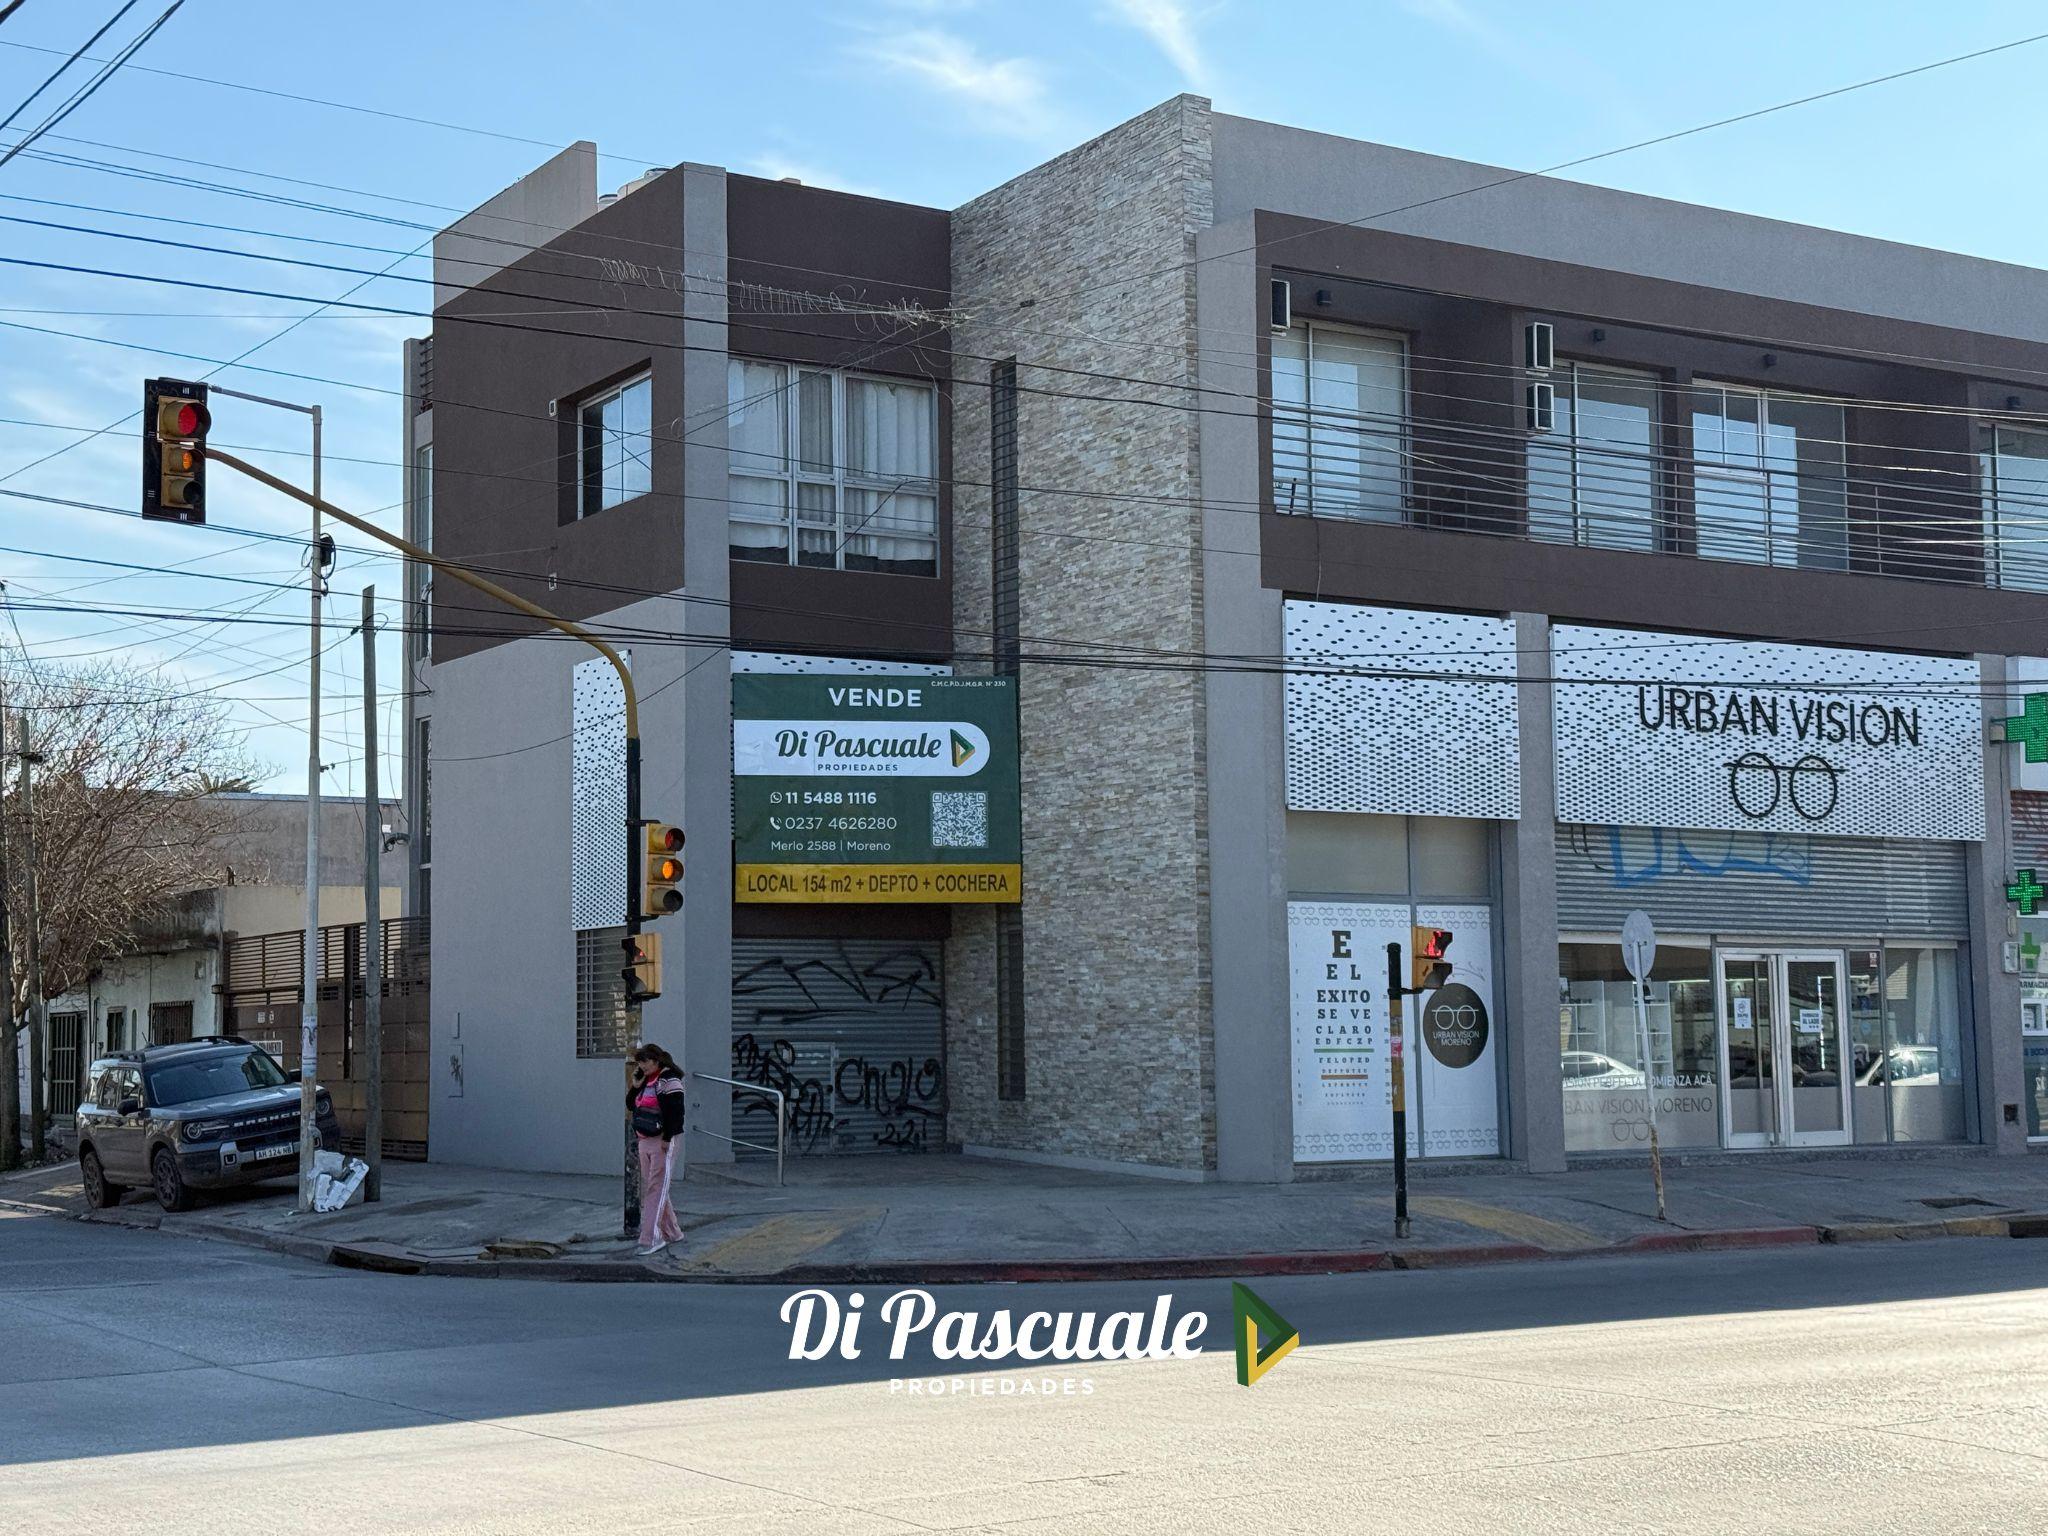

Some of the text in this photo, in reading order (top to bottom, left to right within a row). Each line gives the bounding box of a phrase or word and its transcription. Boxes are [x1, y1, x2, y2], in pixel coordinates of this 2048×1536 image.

[828, 687, 922, 707] VENDE
[1638, 685, 1920, 747] URBAN VISION
[775, 729, 942, 758] Di Pascuale
[817, 764, 898, 772] PROPIEDADES
[785, 791, 877, 804] 11 5488 1116
[785, 817, 897, 830] 0237 4626280
[771, 840, 803, 851] Merlo
[807, 841, 836, 851] 2588
[847, 841, 891, 851] Moreno
[748, 874, 798, 893] LOCAL
[802, 874, 826, 893] 154
[831, 874, 852, 893] m2
[869, 874, 918, 893] DEPTO
[935, 874, 1008, 893] COCHERA
[1331, 930, 1352, 958] E
[1317, 989, 1371, 1003] EXITO
[1317, 1008, 1371, 1019] SE VE
[1315, 1025, 1372, 1034] CLARO
[1432, 1031, 1480, 1039] URBAN VISION
[1652, 1075, 1691, 1086] OMIENZA
[1694, 1072, 1713, 1086] ACÁ
[1599, 1098, 1645, 1113] VISION
